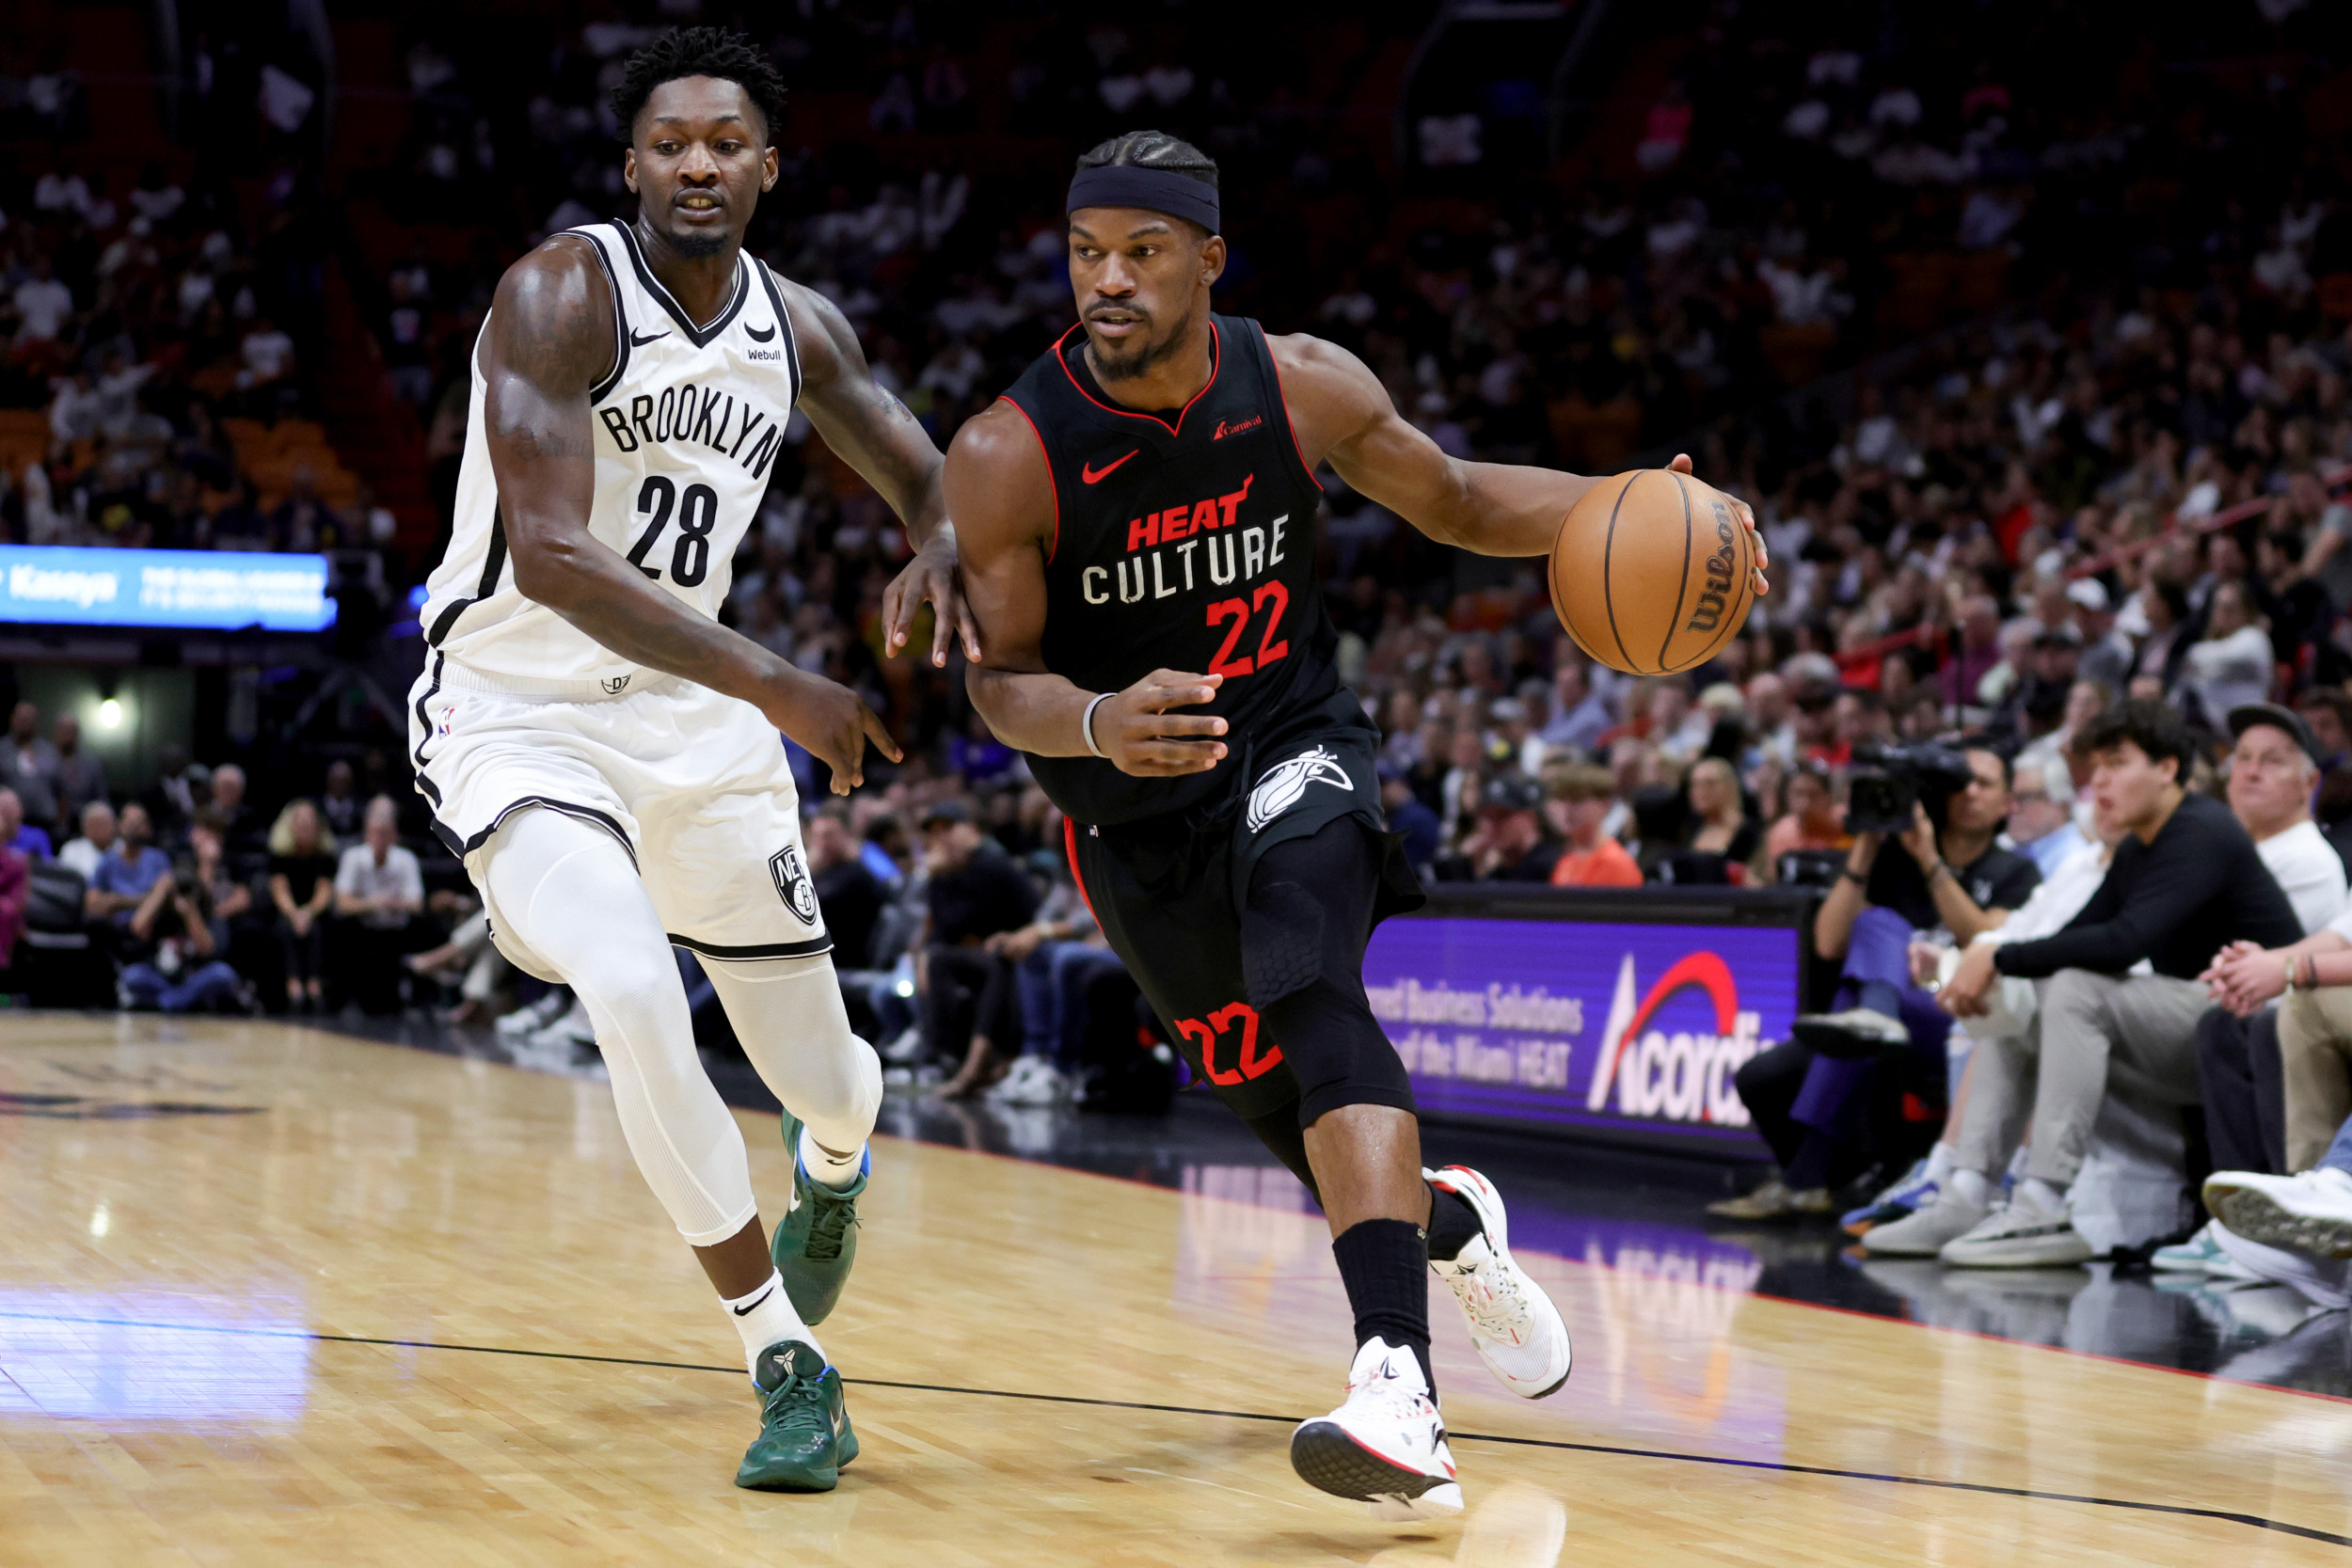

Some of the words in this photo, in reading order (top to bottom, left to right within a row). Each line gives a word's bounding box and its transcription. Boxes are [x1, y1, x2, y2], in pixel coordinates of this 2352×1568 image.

[747, 349, 781, 360] Webull
[599, 384, 783, 481] BROOKLYN
[1224, 415, 1263, 436] Carnival
[626, 475, 718, 588] 28
[1126, 472, 1255, 553] HEAT
[1082, 514, 1289, 605] CULTURE
[1685, 500, 1737, 633] Wilson
[1206, 579, 1289, 680] 22
[1174, 1001, 1284, 1085] 22
[1486, 981, 1584, 1036] Solutions
[1587, 952, 1777, 1128] Acordi
[1516, 1039, 1573, 1088] HEAT
